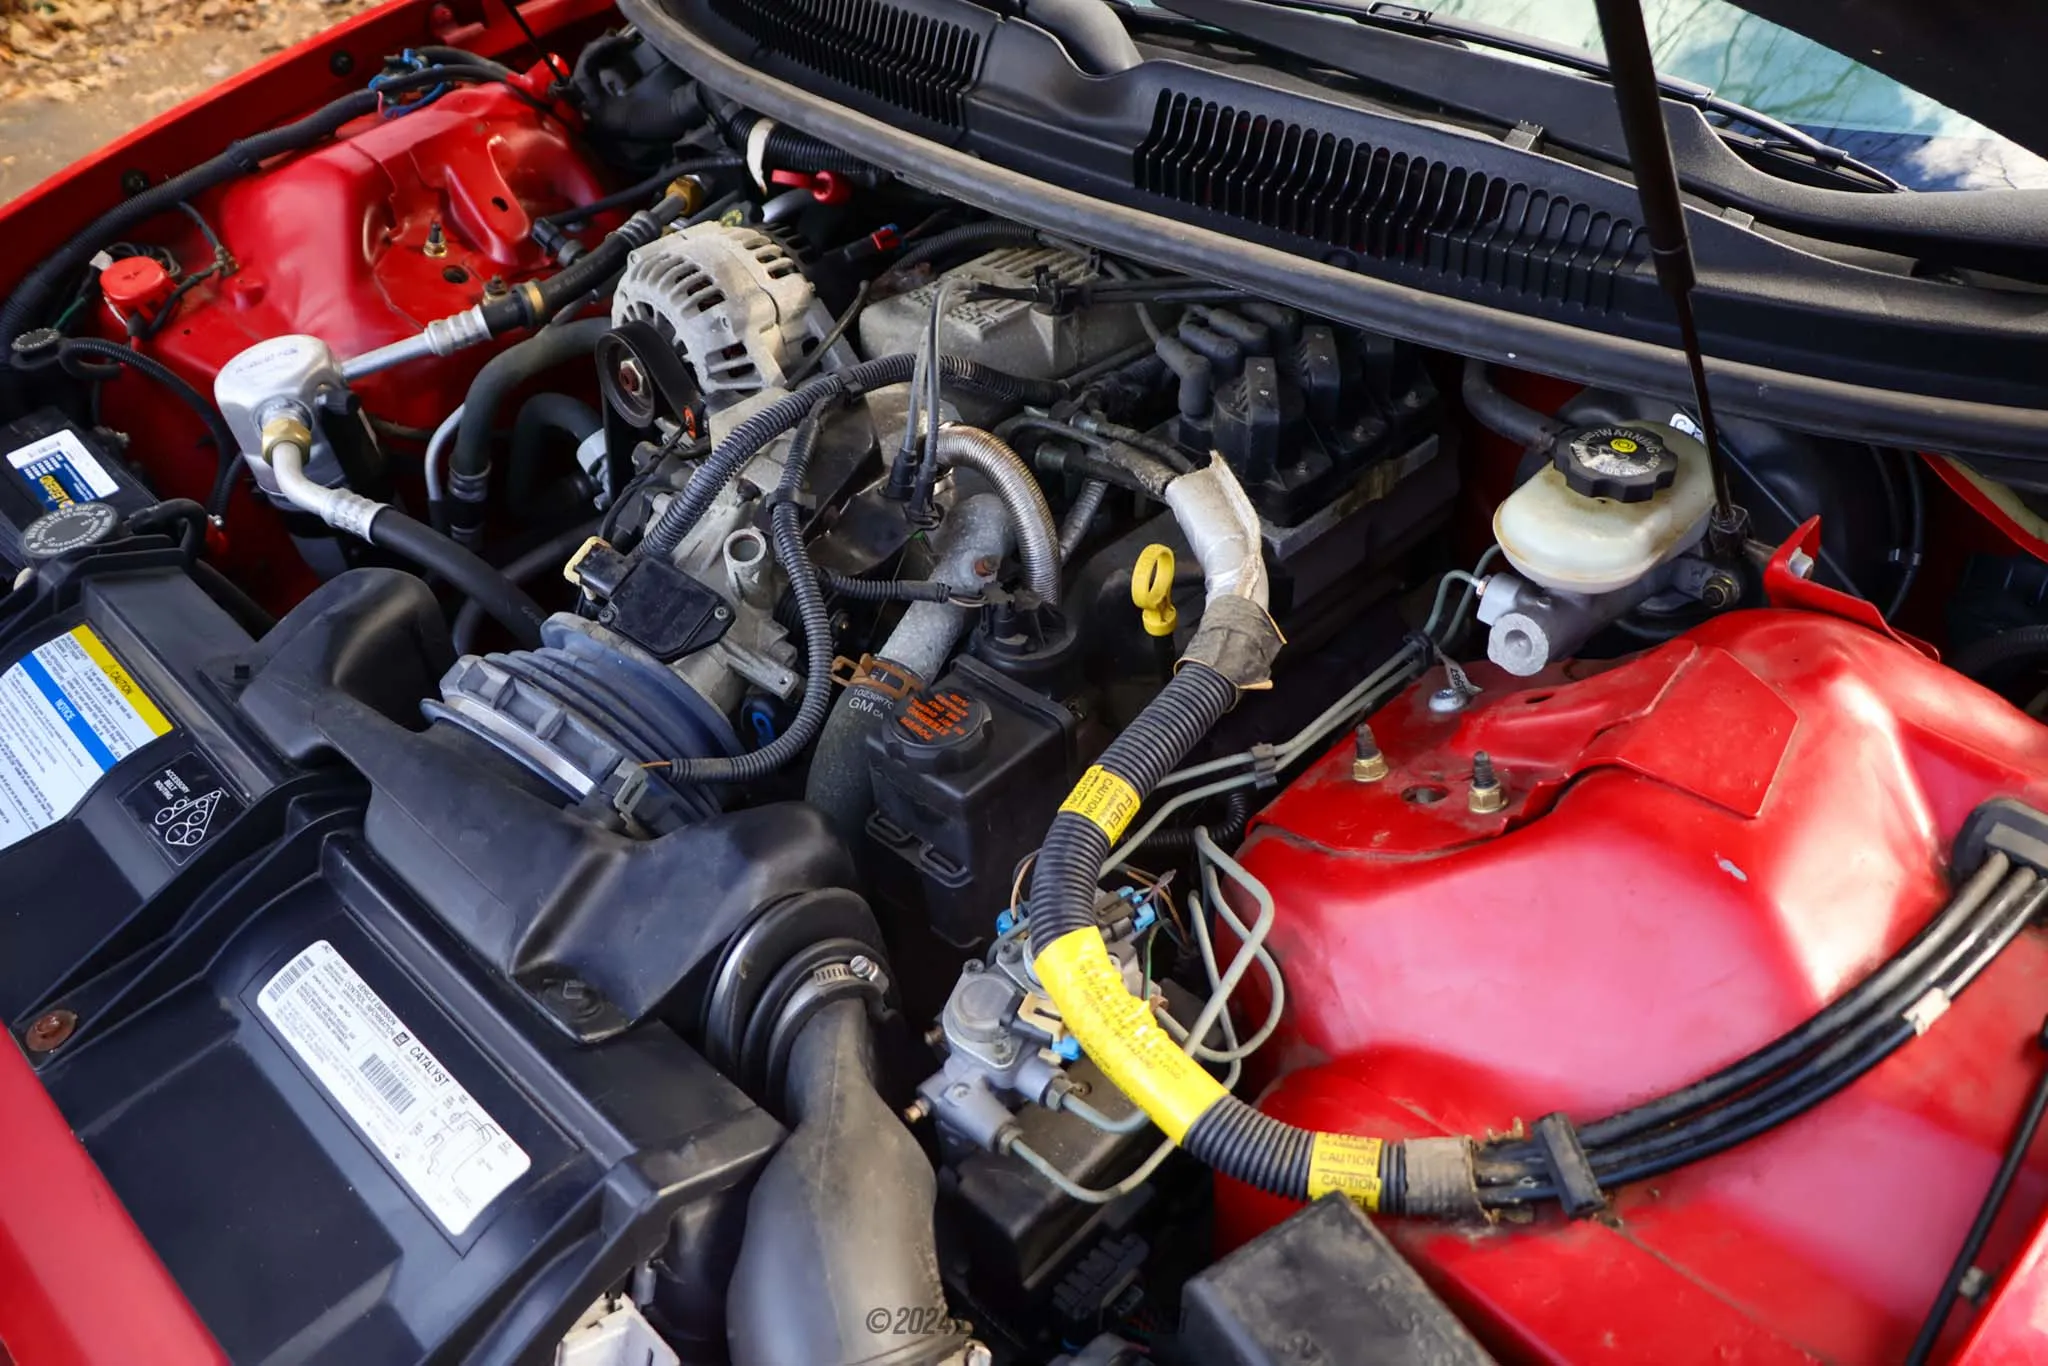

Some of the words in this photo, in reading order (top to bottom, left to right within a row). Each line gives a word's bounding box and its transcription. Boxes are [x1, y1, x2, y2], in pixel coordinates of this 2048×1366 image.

[109, 669, 134, 696] CAUTION
[54, 698, 77, 722] NOTICE
[849, 697, 873, 713] GM
[154, 780, 174, 800] ROUTING
[164, 779, 178, 791] BELT
[165, 769, 190, 793] ACCESSORY
[1084, 778, 1113, 816] CAUTION
[1105, 793, 1133, 830] FUEL
[410, 1046, 450, 1087] CATALYST
[1319, 1152, 1377, 1168] CAUTION
[1321, 1174, 1378, 1192] CAUTION
